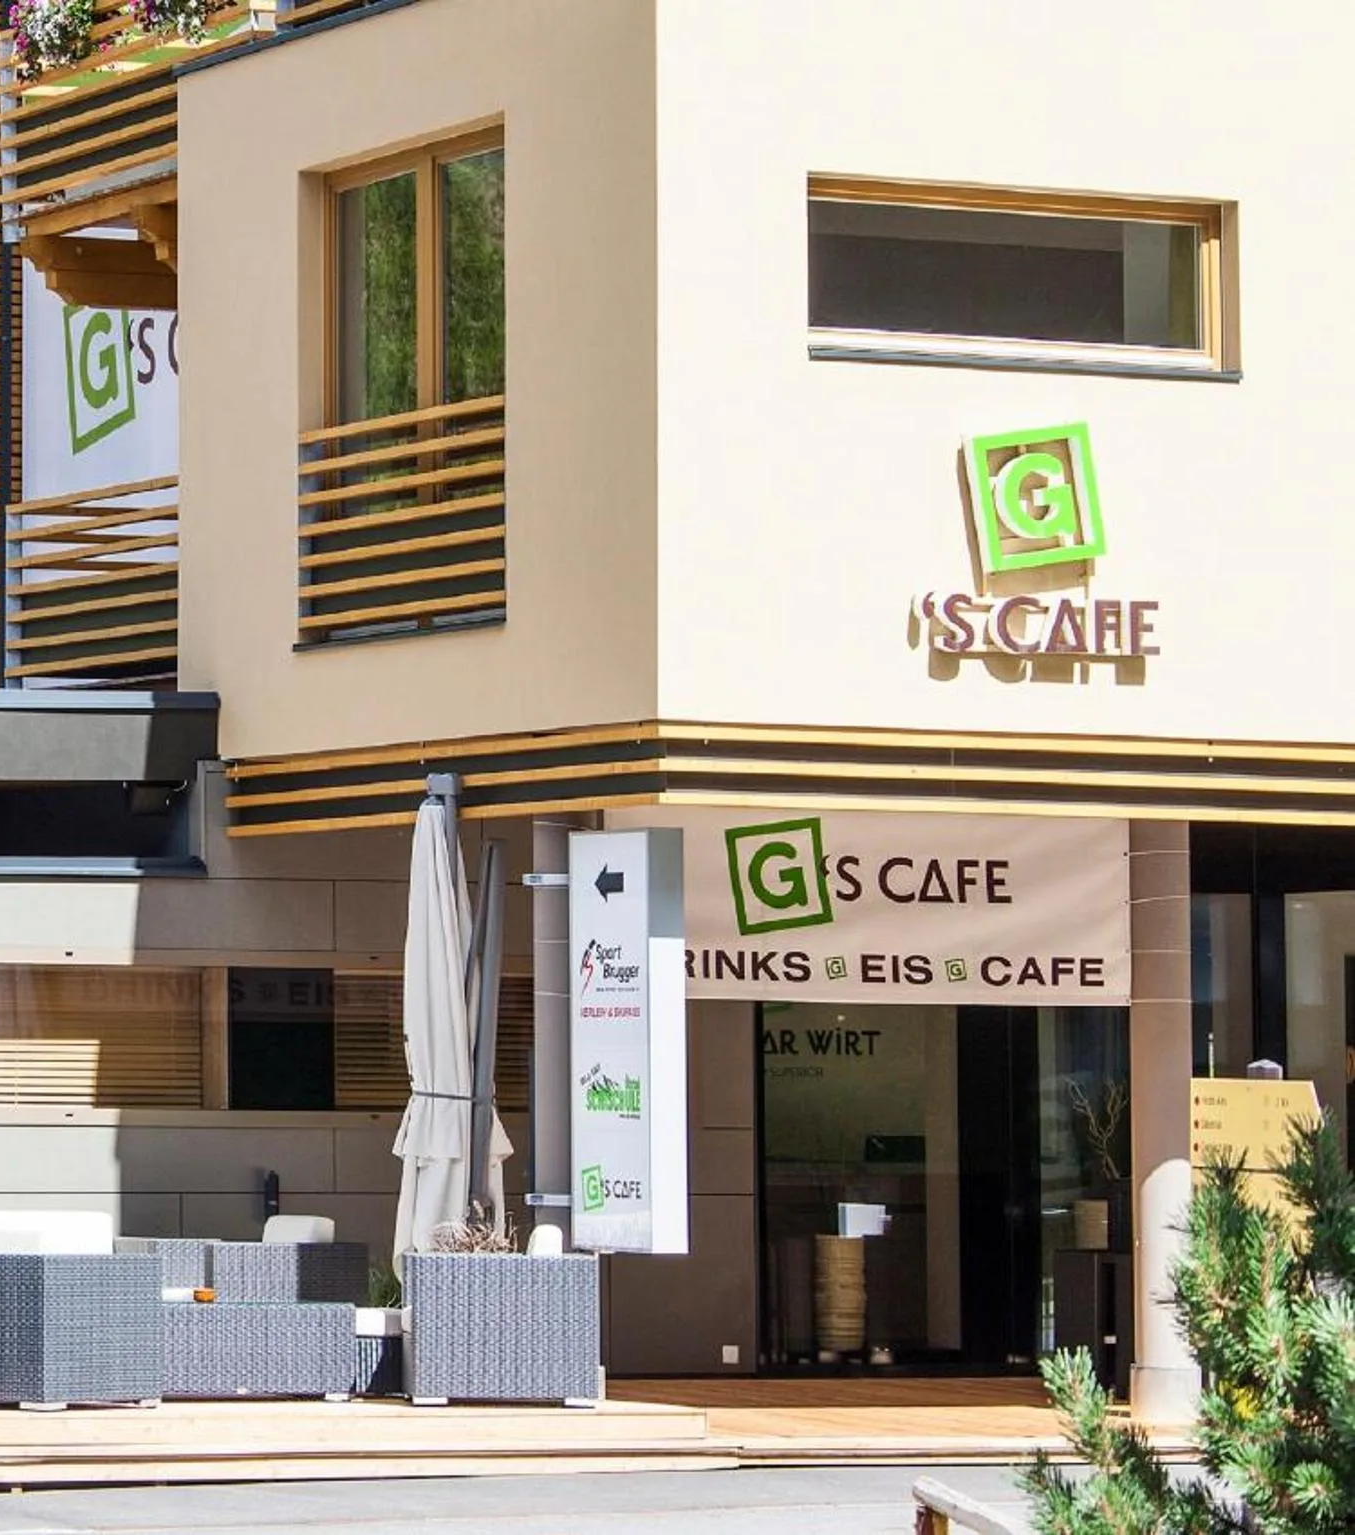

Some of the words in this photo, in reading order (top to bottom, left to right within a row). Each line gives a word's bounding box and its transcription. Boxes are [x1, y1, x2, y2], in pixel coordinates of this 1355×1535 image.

[995, 595, 1161, 656] CAFE
[877, 855, 1013, 904] CAFE
[596, 943, 622, 965] Sport
[603, 963, 640, 983] Brugger
[860, 953, 934, 985] EIS
[980, 956, 1105, 987] CAFE
[612, 1180, 642, 1200] CAFE
